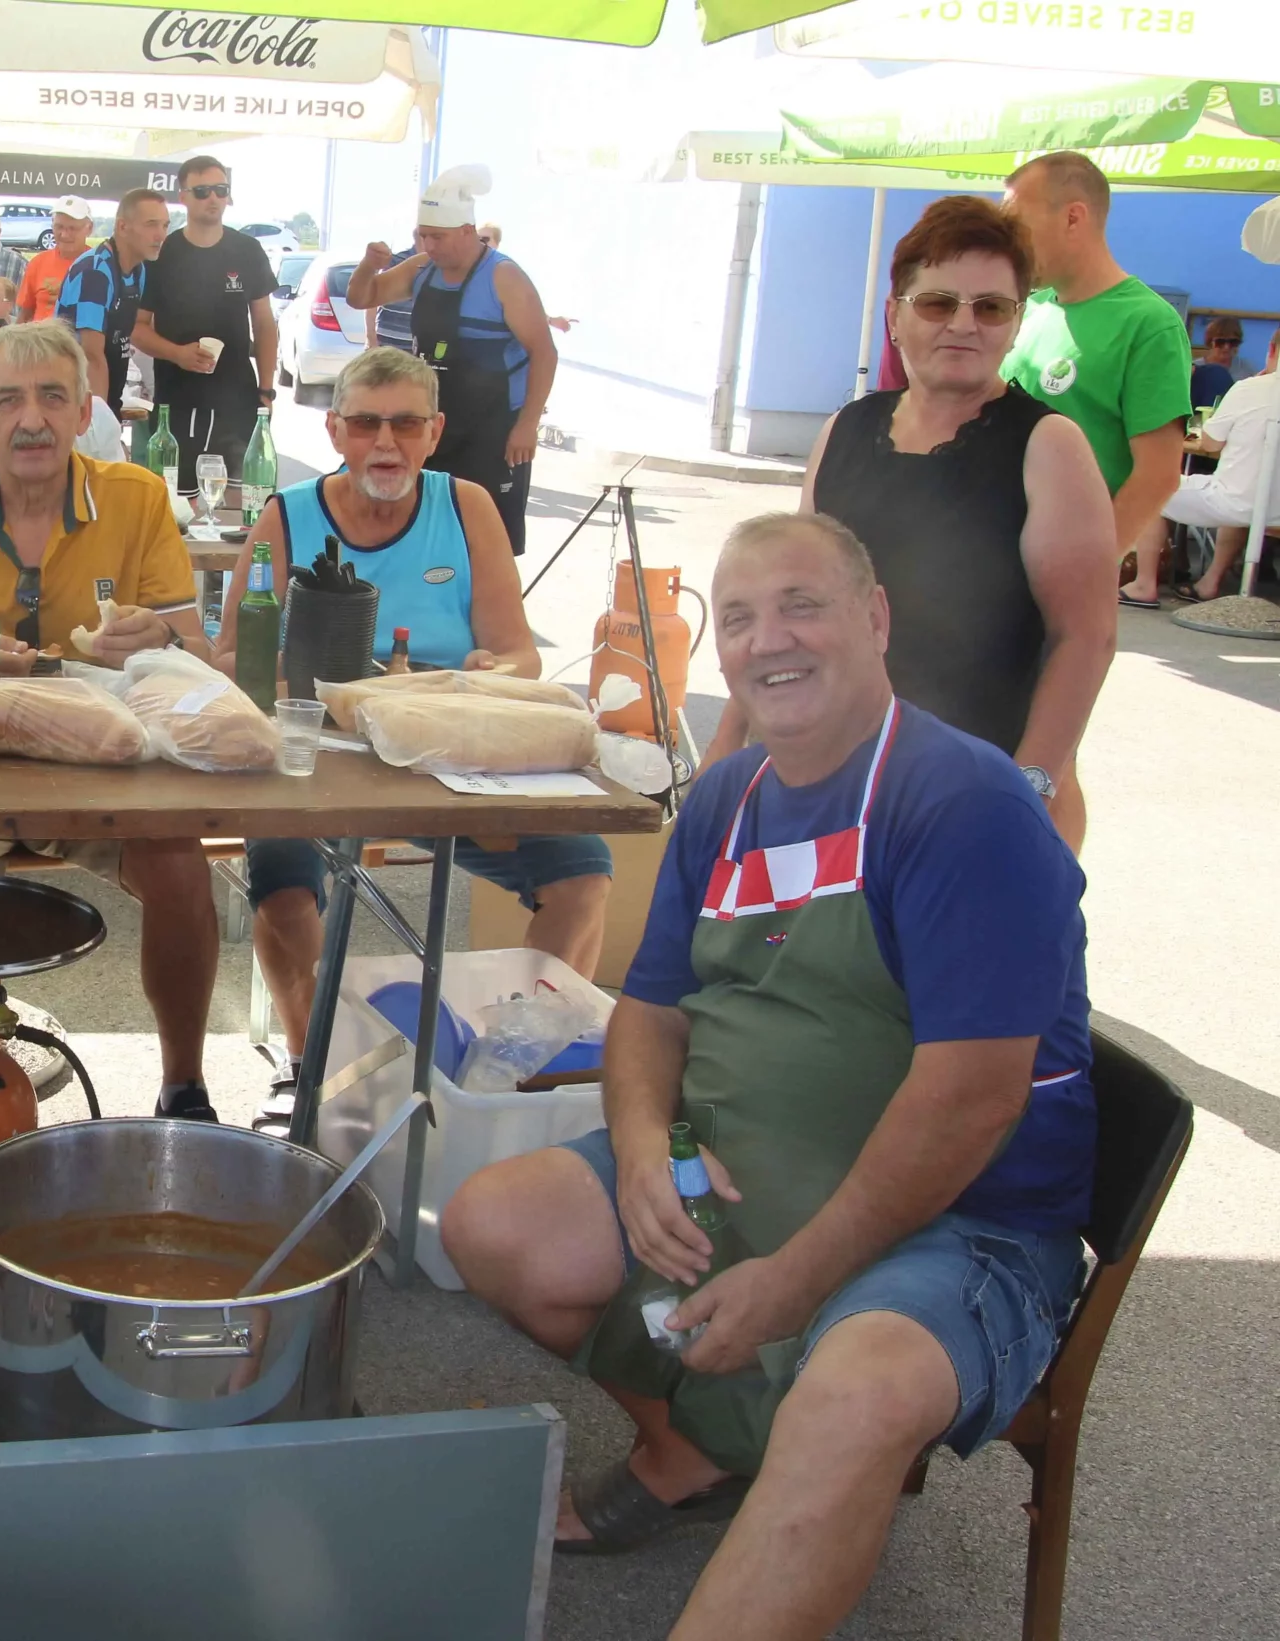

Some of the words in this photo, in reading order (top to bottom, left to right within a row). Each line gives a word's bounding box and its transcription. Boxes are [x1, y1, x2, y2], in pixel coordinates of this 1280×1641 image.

[1160, 92, 1190, 112] ICE
[712, 151, 752, 166] BEST
[54, 171, 102, 188] VODA
